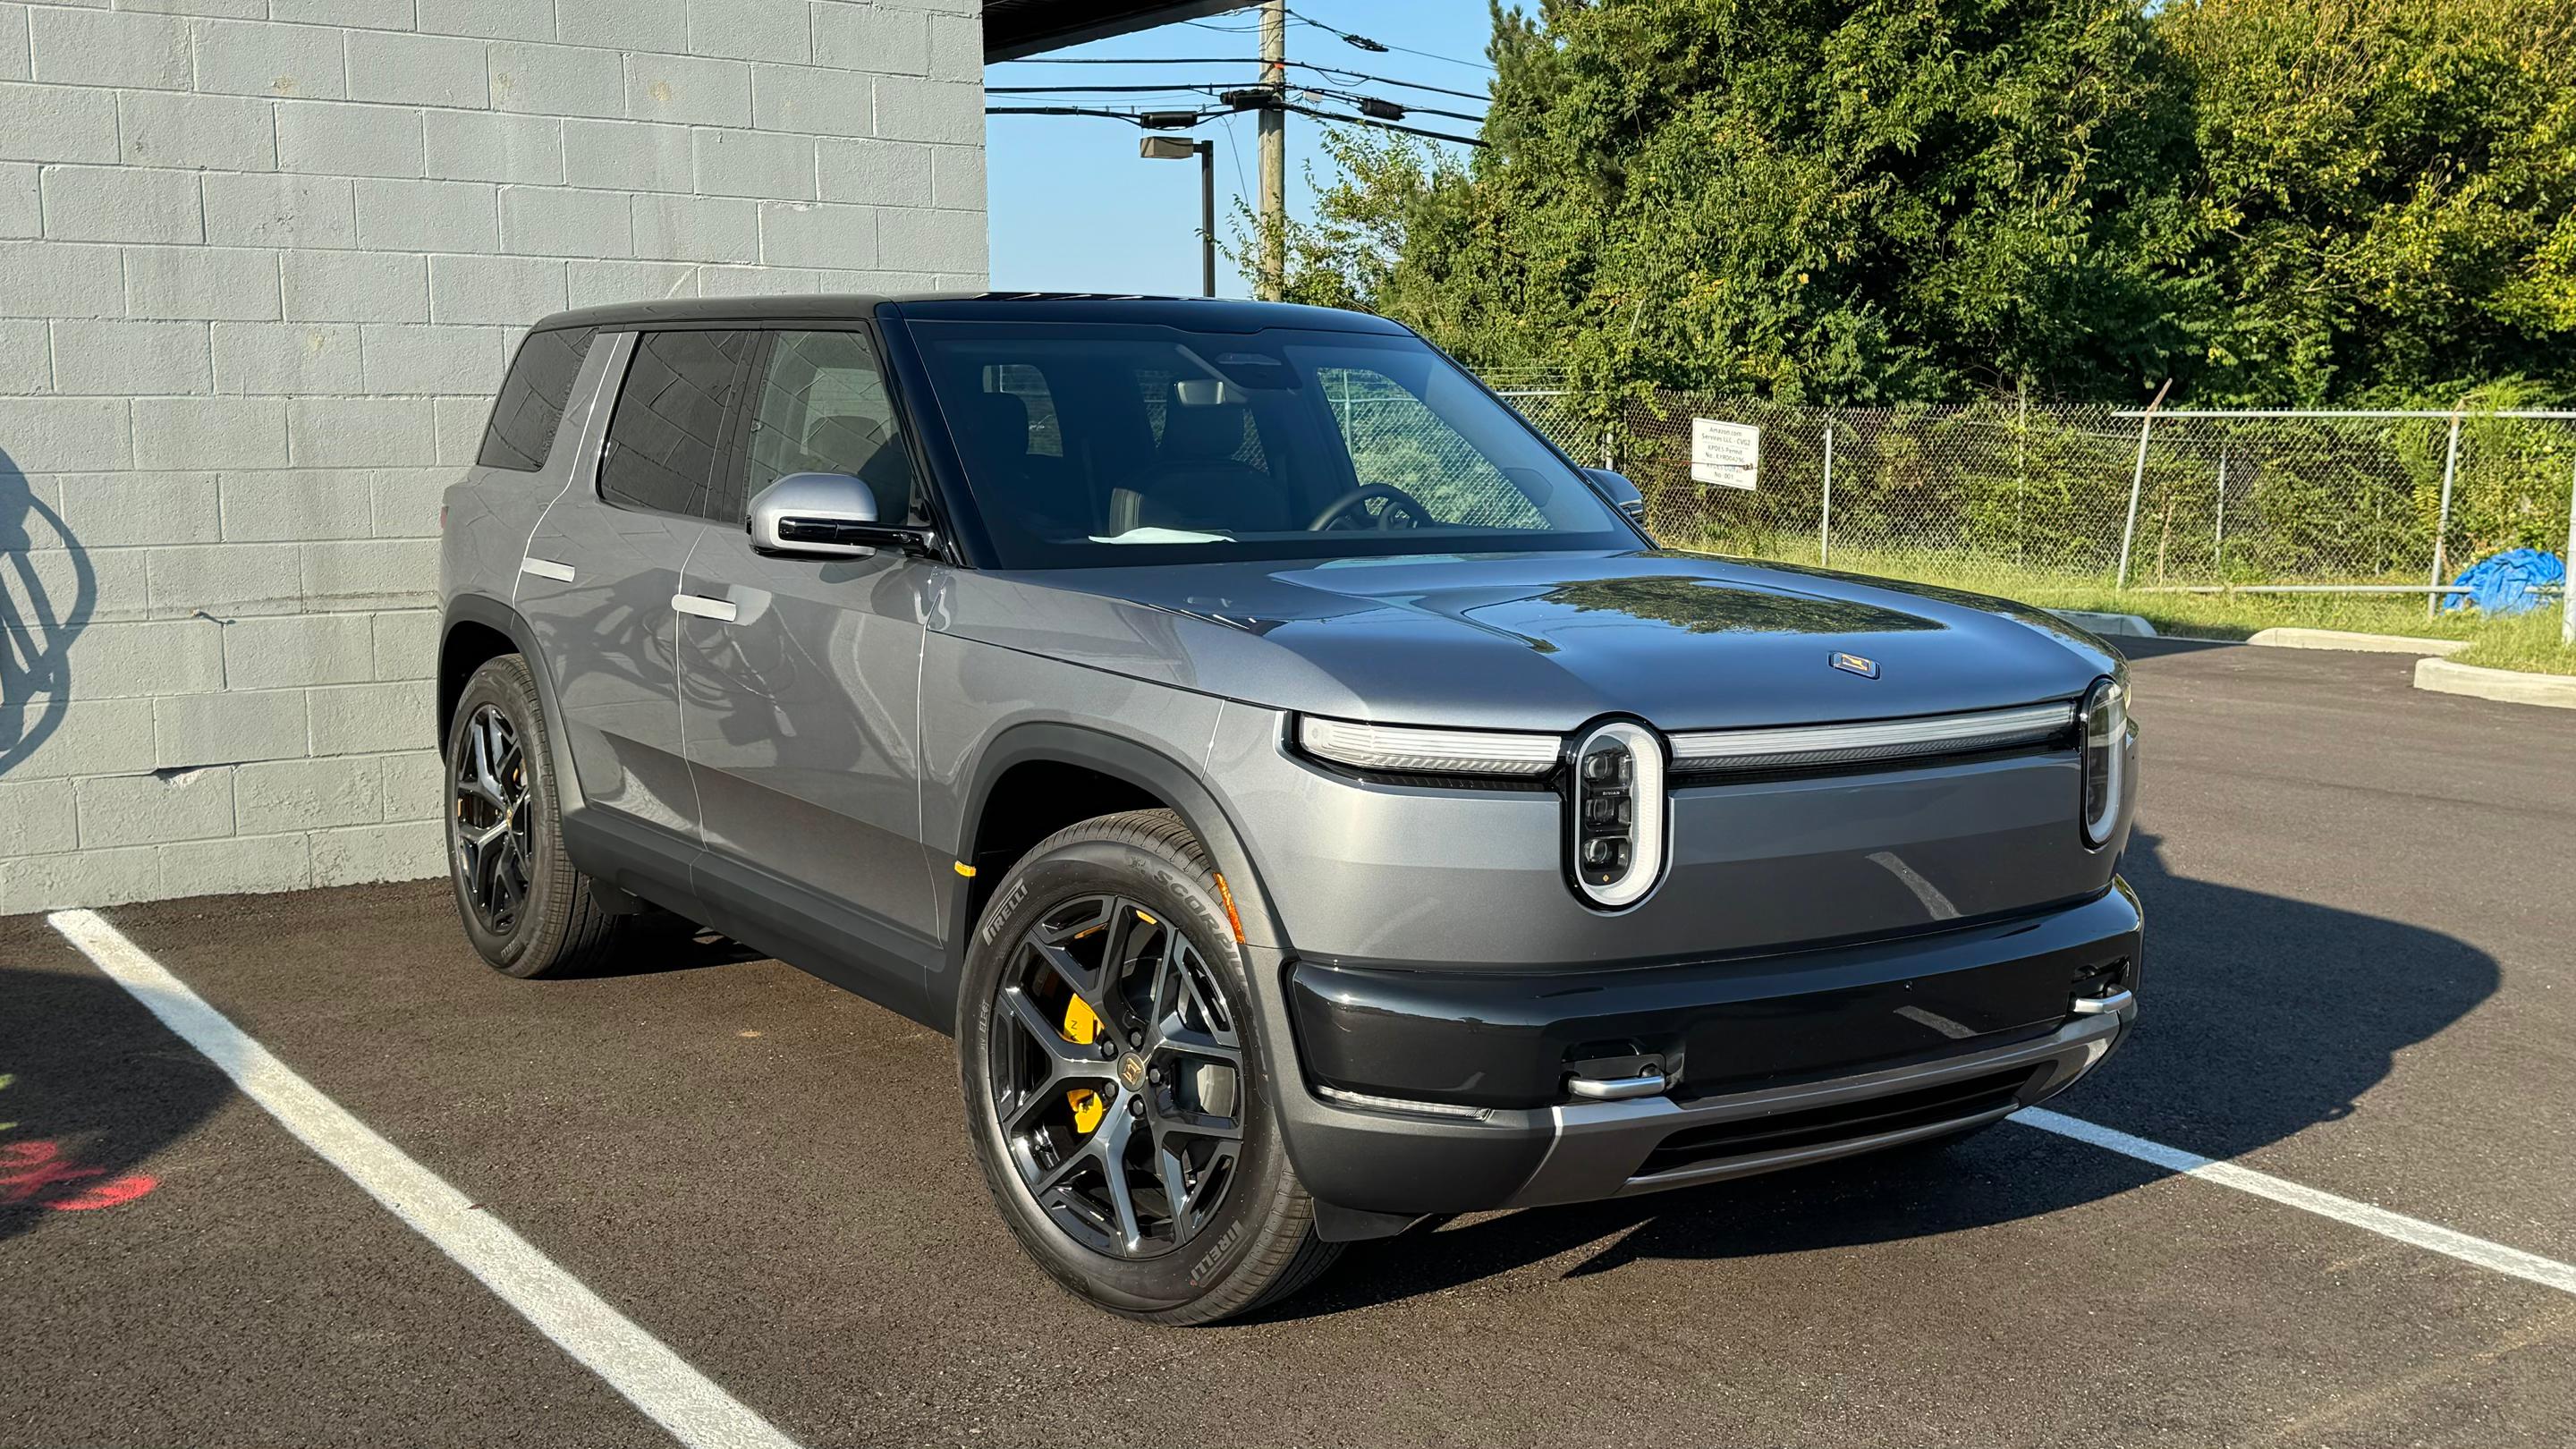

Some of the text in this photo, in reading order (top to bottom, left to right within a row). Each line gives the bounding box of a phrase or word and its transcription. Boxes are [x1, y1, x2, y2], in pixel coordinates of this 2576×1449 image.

[1701, 433, 1723, 442] Services
[982, 877, 1029, 946] PIRELLI
[1191, 1220, 1251, 1287] PIRELLI
